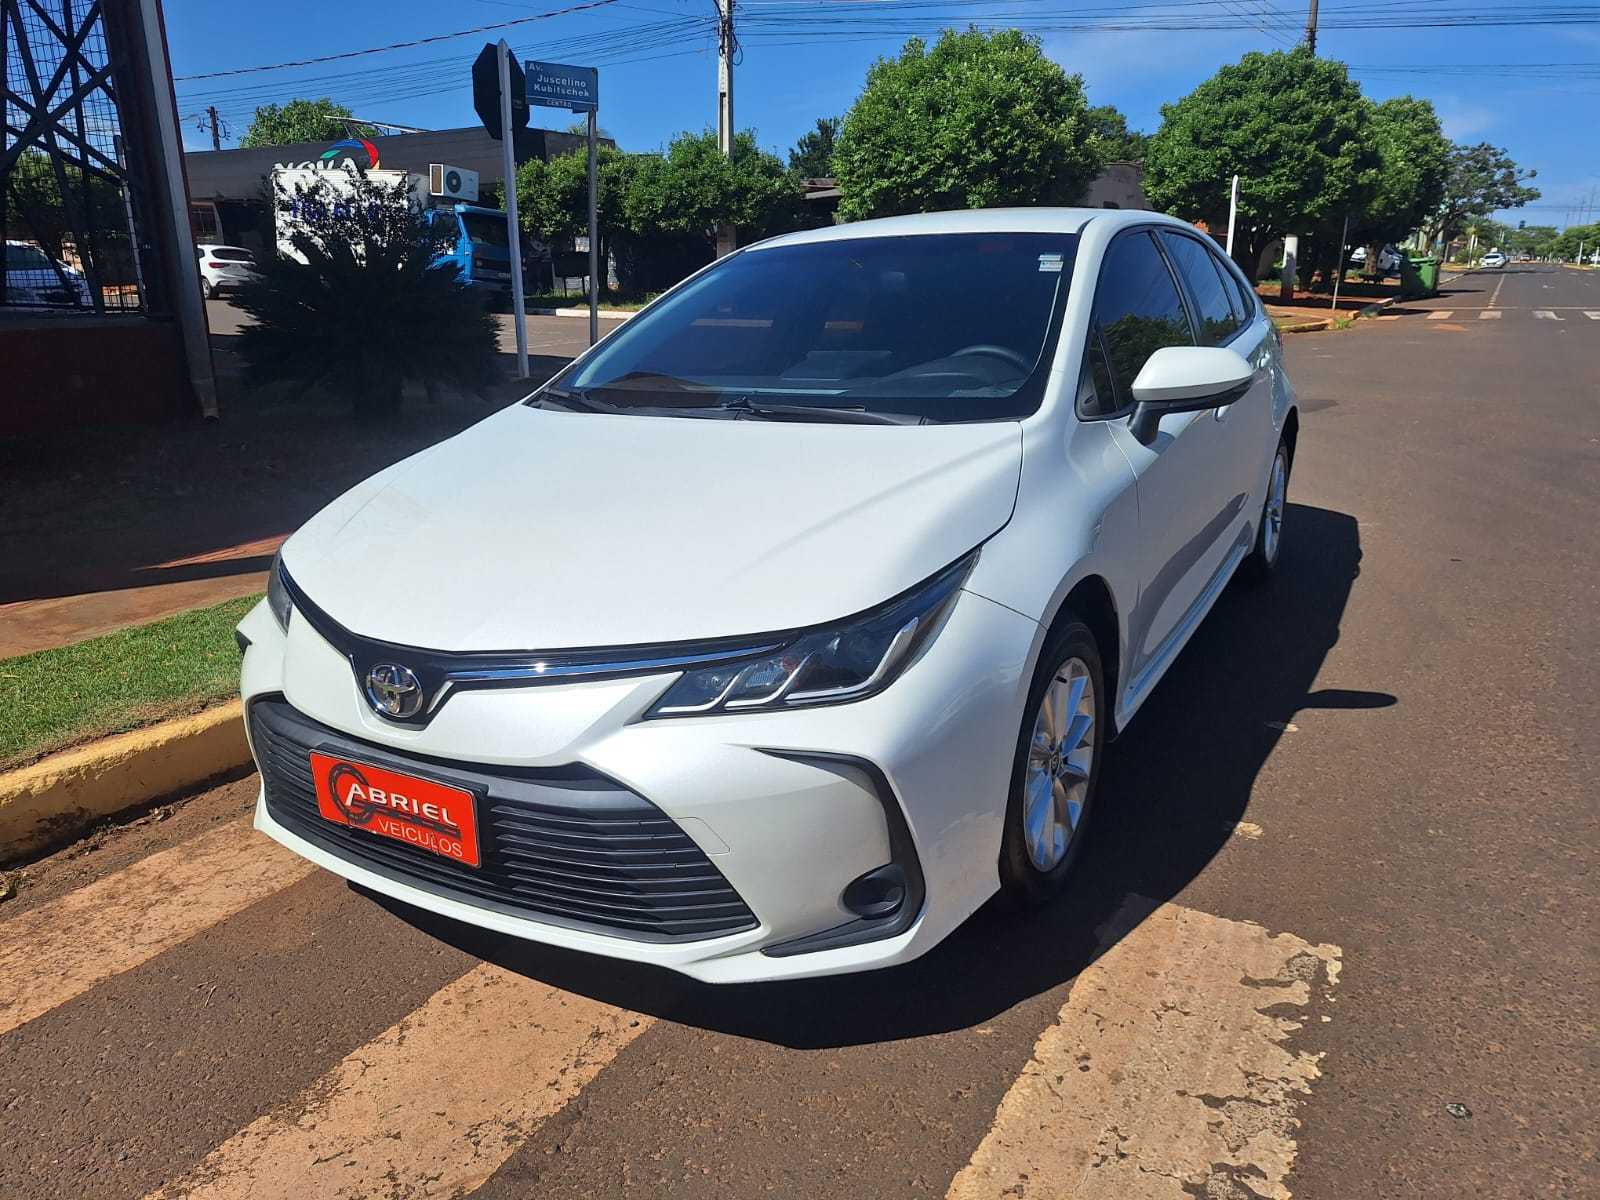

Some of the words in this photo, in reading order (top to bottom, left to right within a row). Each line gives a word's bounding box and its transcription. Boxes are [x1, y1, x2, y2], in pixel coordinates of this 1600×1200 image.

[529, 63, 543, 72] Av.
[537, 75, 586, 87] Juscelino
[534, 84, 589, 97] Kubitschek
